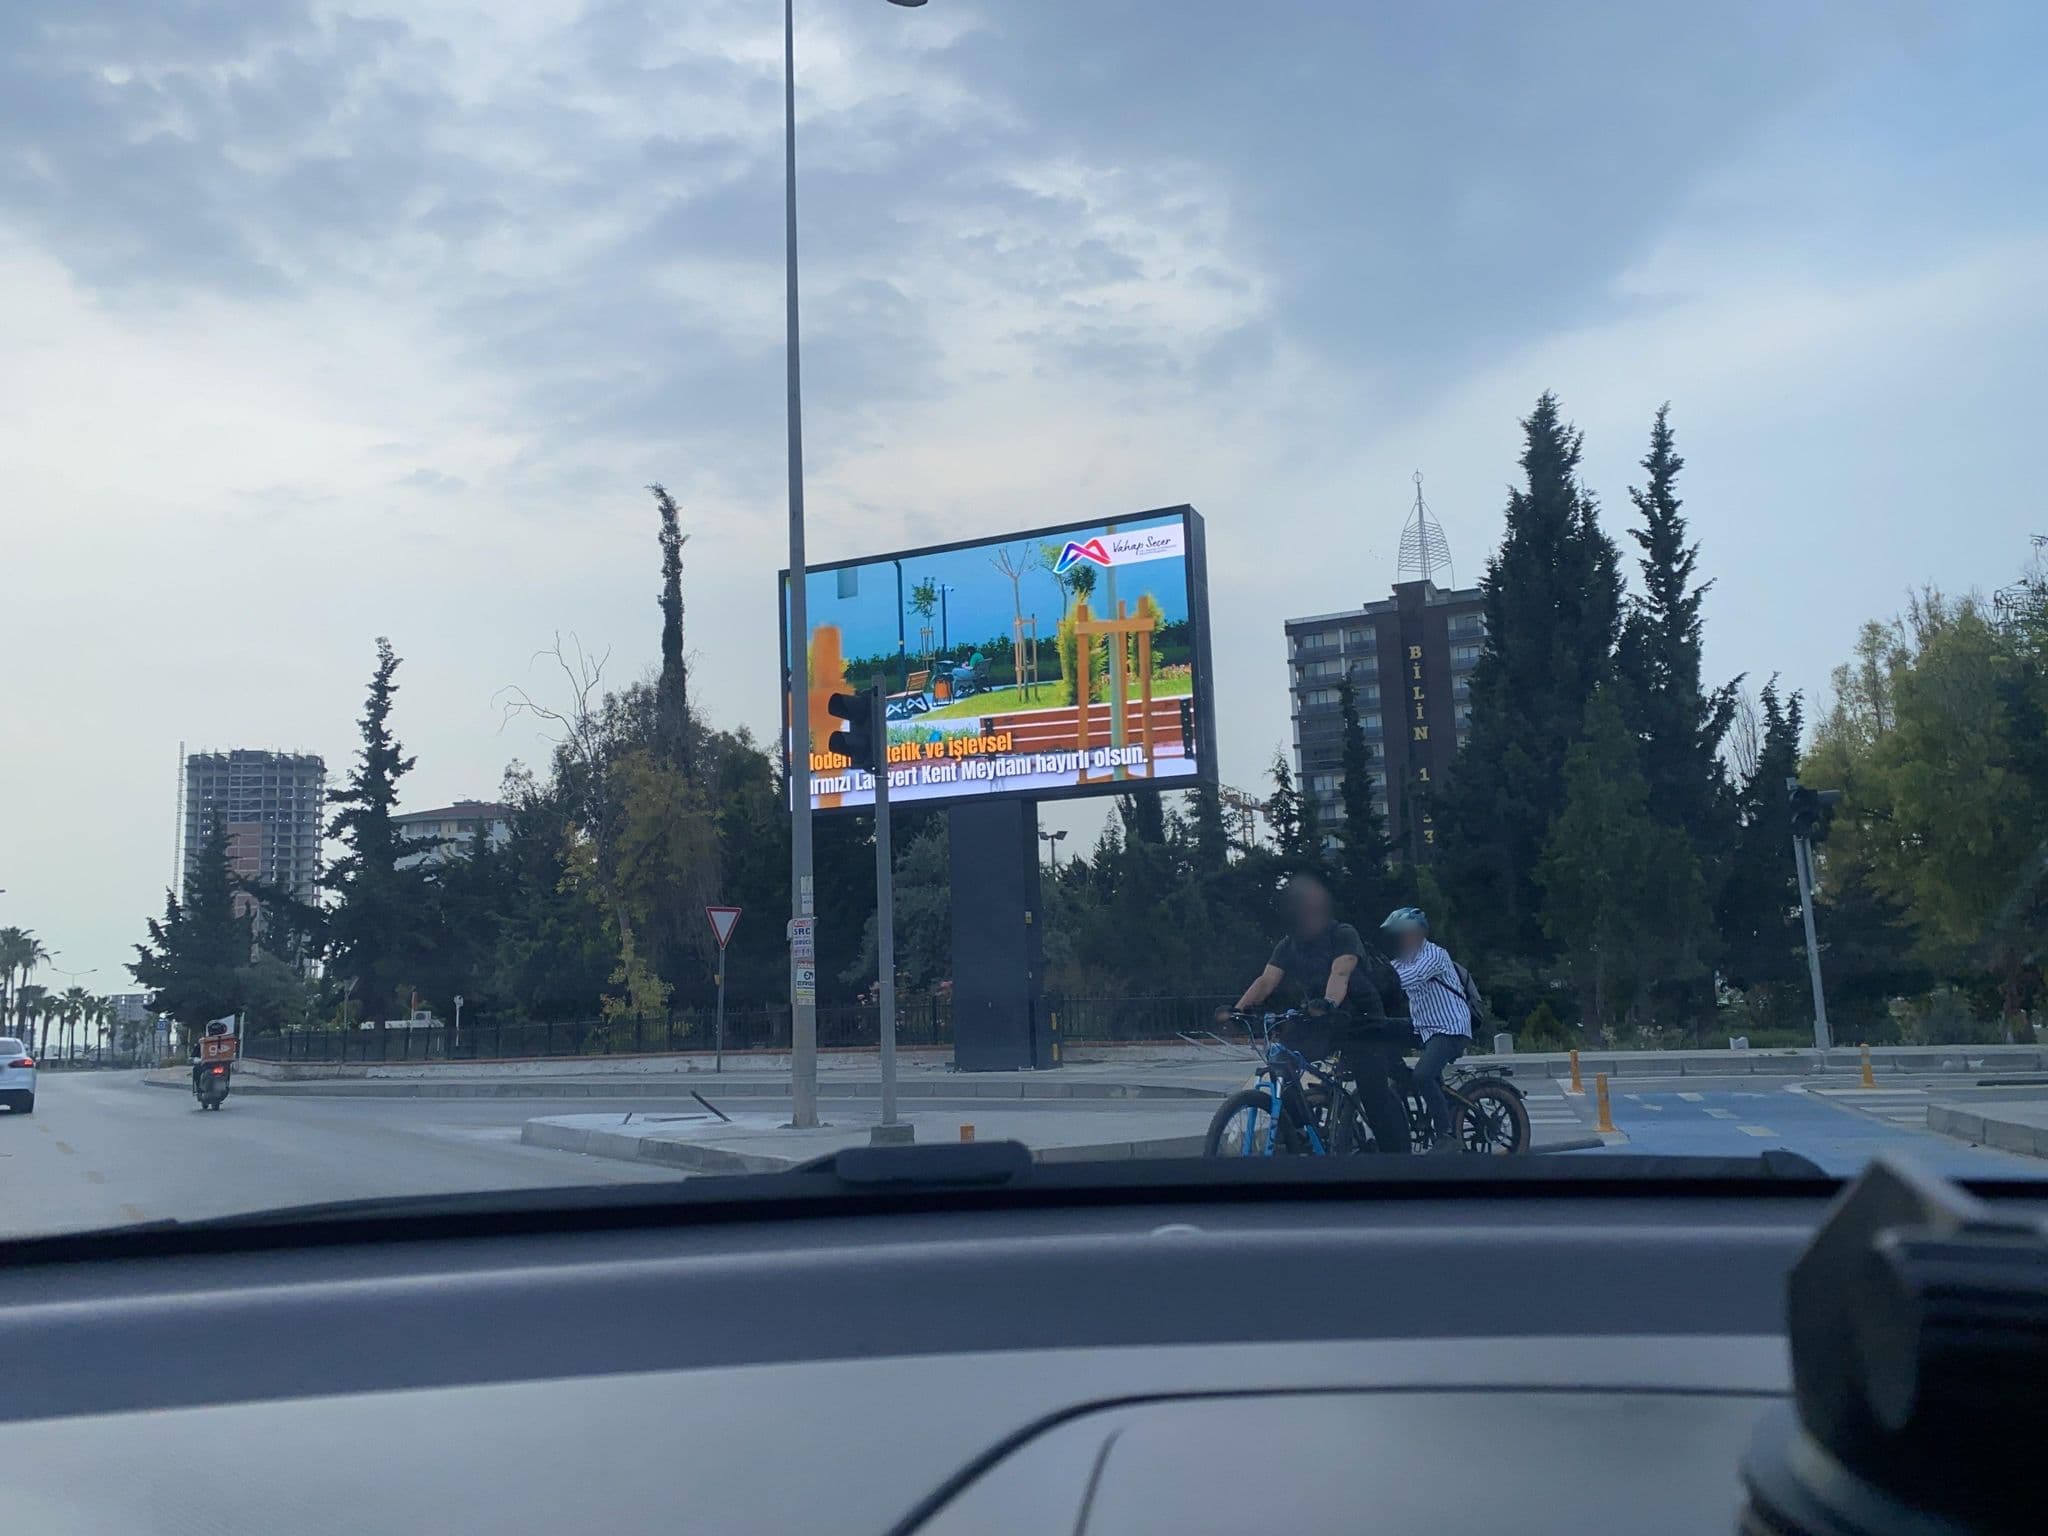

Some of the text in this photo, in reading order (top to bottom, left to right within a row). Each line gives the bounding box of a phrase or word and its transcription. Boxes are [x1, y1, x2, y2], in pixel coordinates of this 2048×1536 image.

[1408, 645, 1429, 741] BİLİN
[810, 746, 1149, 795] ırmızı Lavert Kent Meydanı hayırlı olsun.
[886, 742, 922, 763] tetik
[925, 742, 945, 759] ve
[948, 732, 1012, 762] işlevsel
